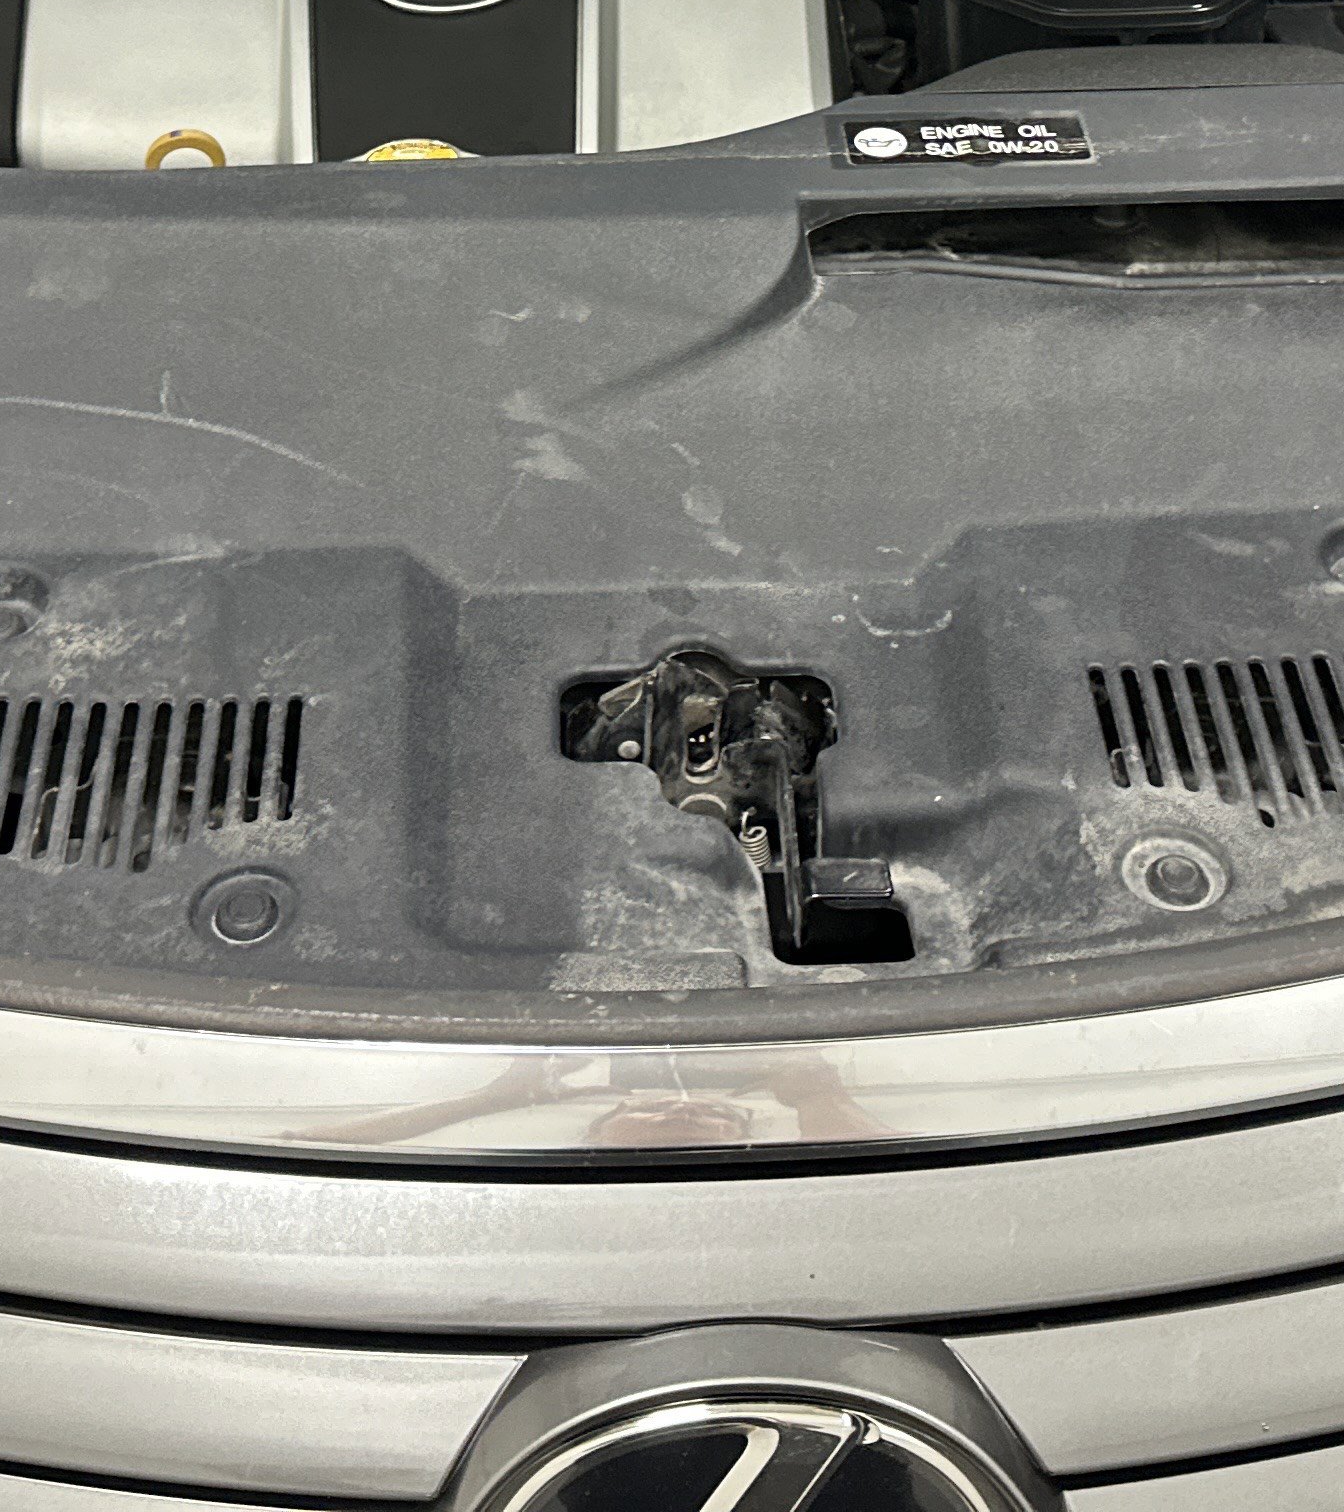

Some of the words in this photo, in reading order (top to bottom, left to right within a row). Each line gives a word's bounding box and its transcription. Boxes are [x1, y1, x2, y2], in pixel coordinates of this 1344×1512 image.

[919, 123, 1005, 140] ENGINE
[1017, 124, 1057, 138] OIL
[924, 140, 973, 156] SAE
